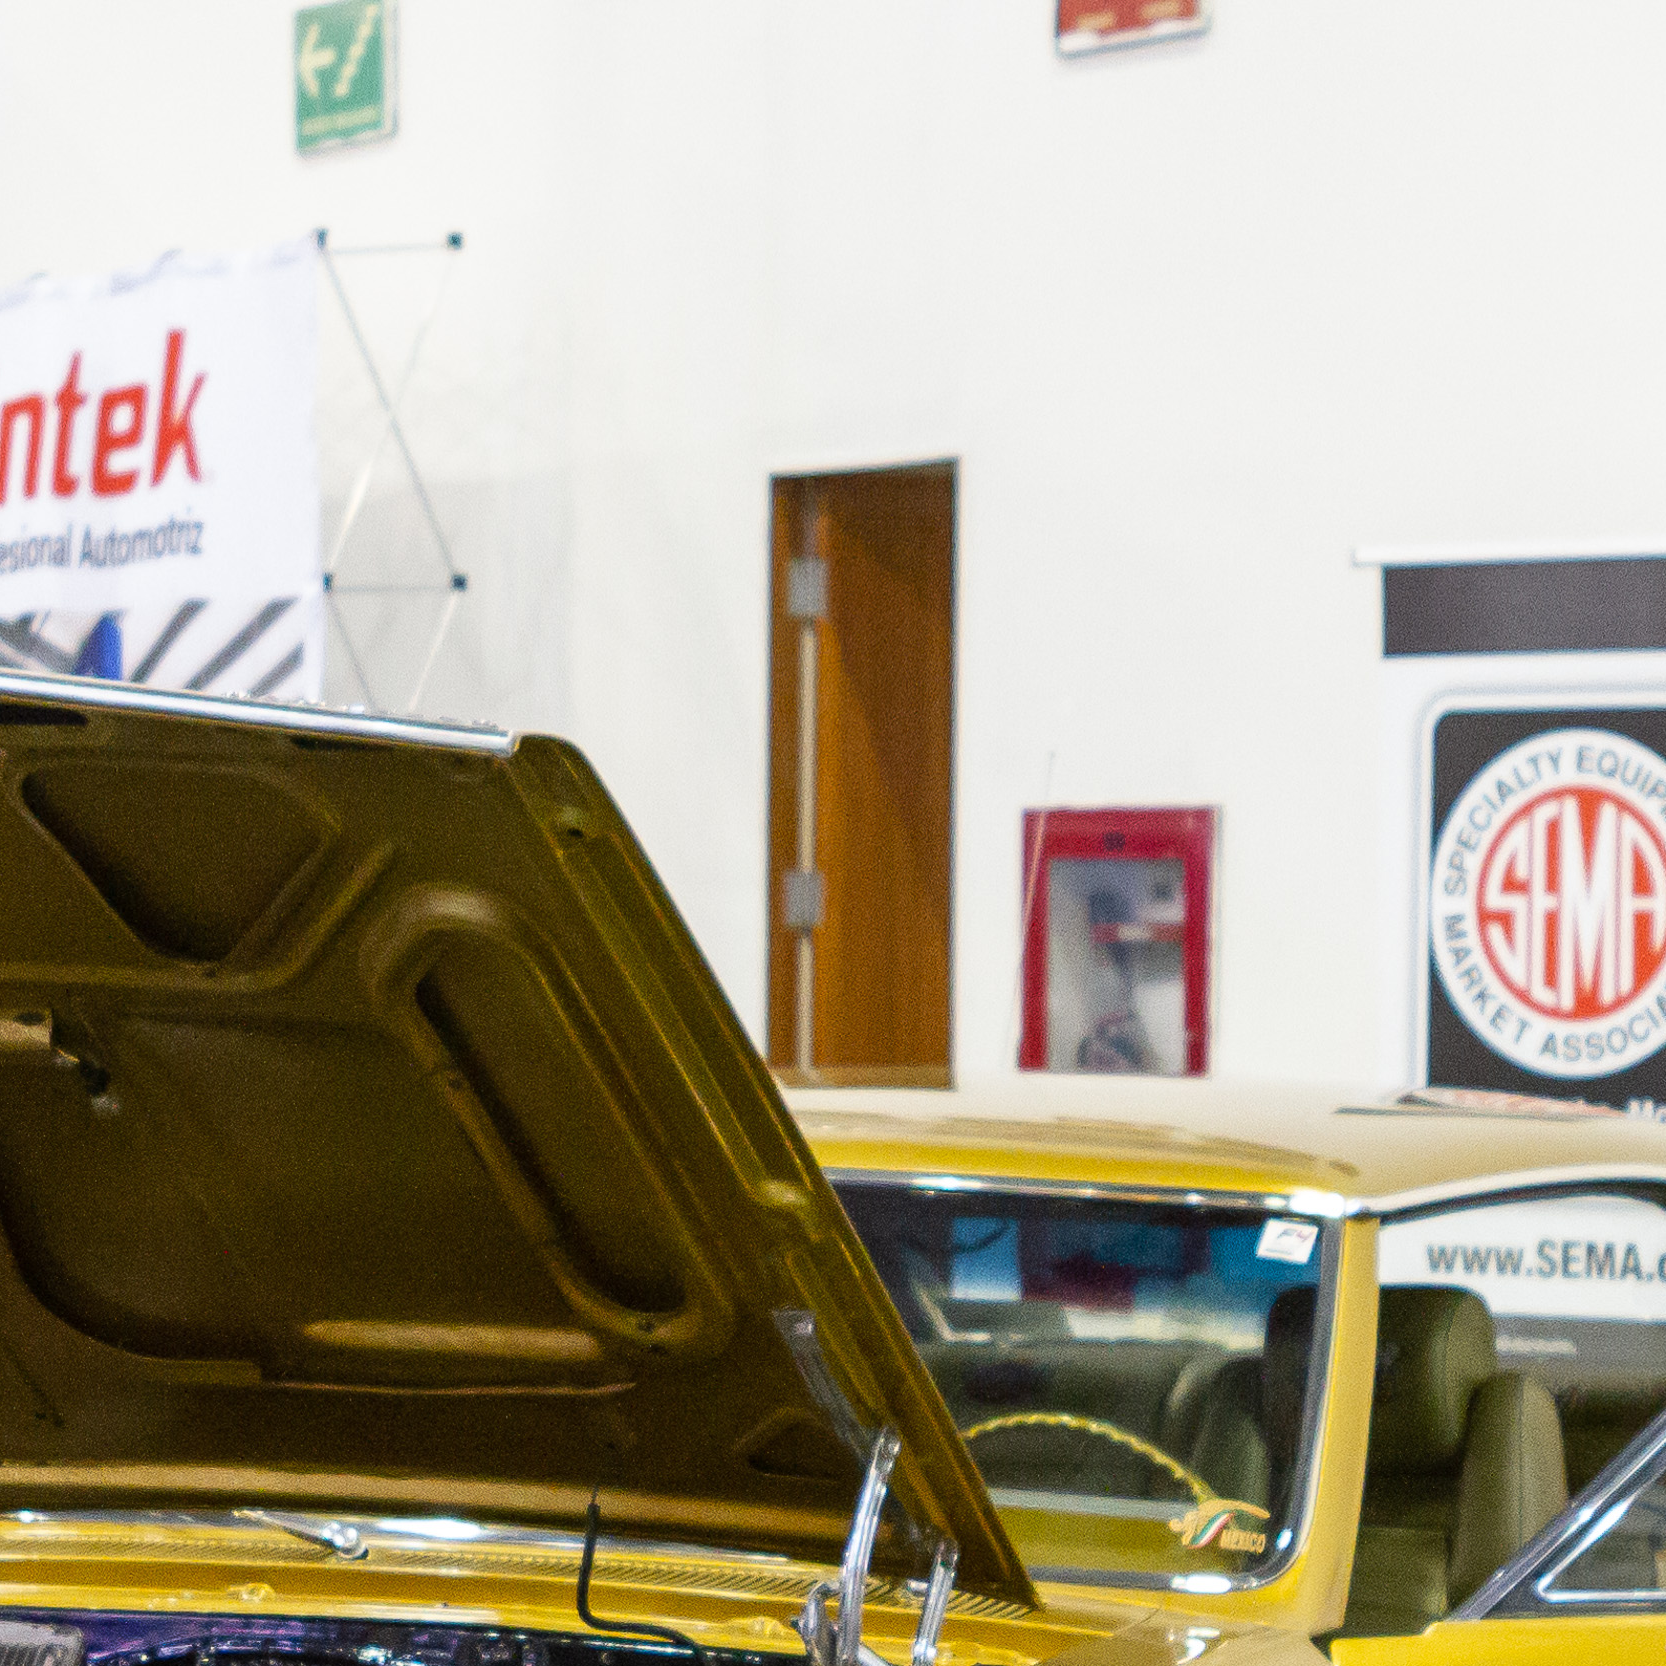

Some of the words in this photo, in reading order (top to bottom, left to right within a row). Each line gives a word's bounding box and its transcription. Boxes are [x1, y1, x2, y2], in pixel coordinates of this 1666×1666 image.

[80, 507, 204, 569] Automotriz
[1444, 747, 1564, 896] SPECIALTY
[1443, 915, 1532, 1044] MARKET
